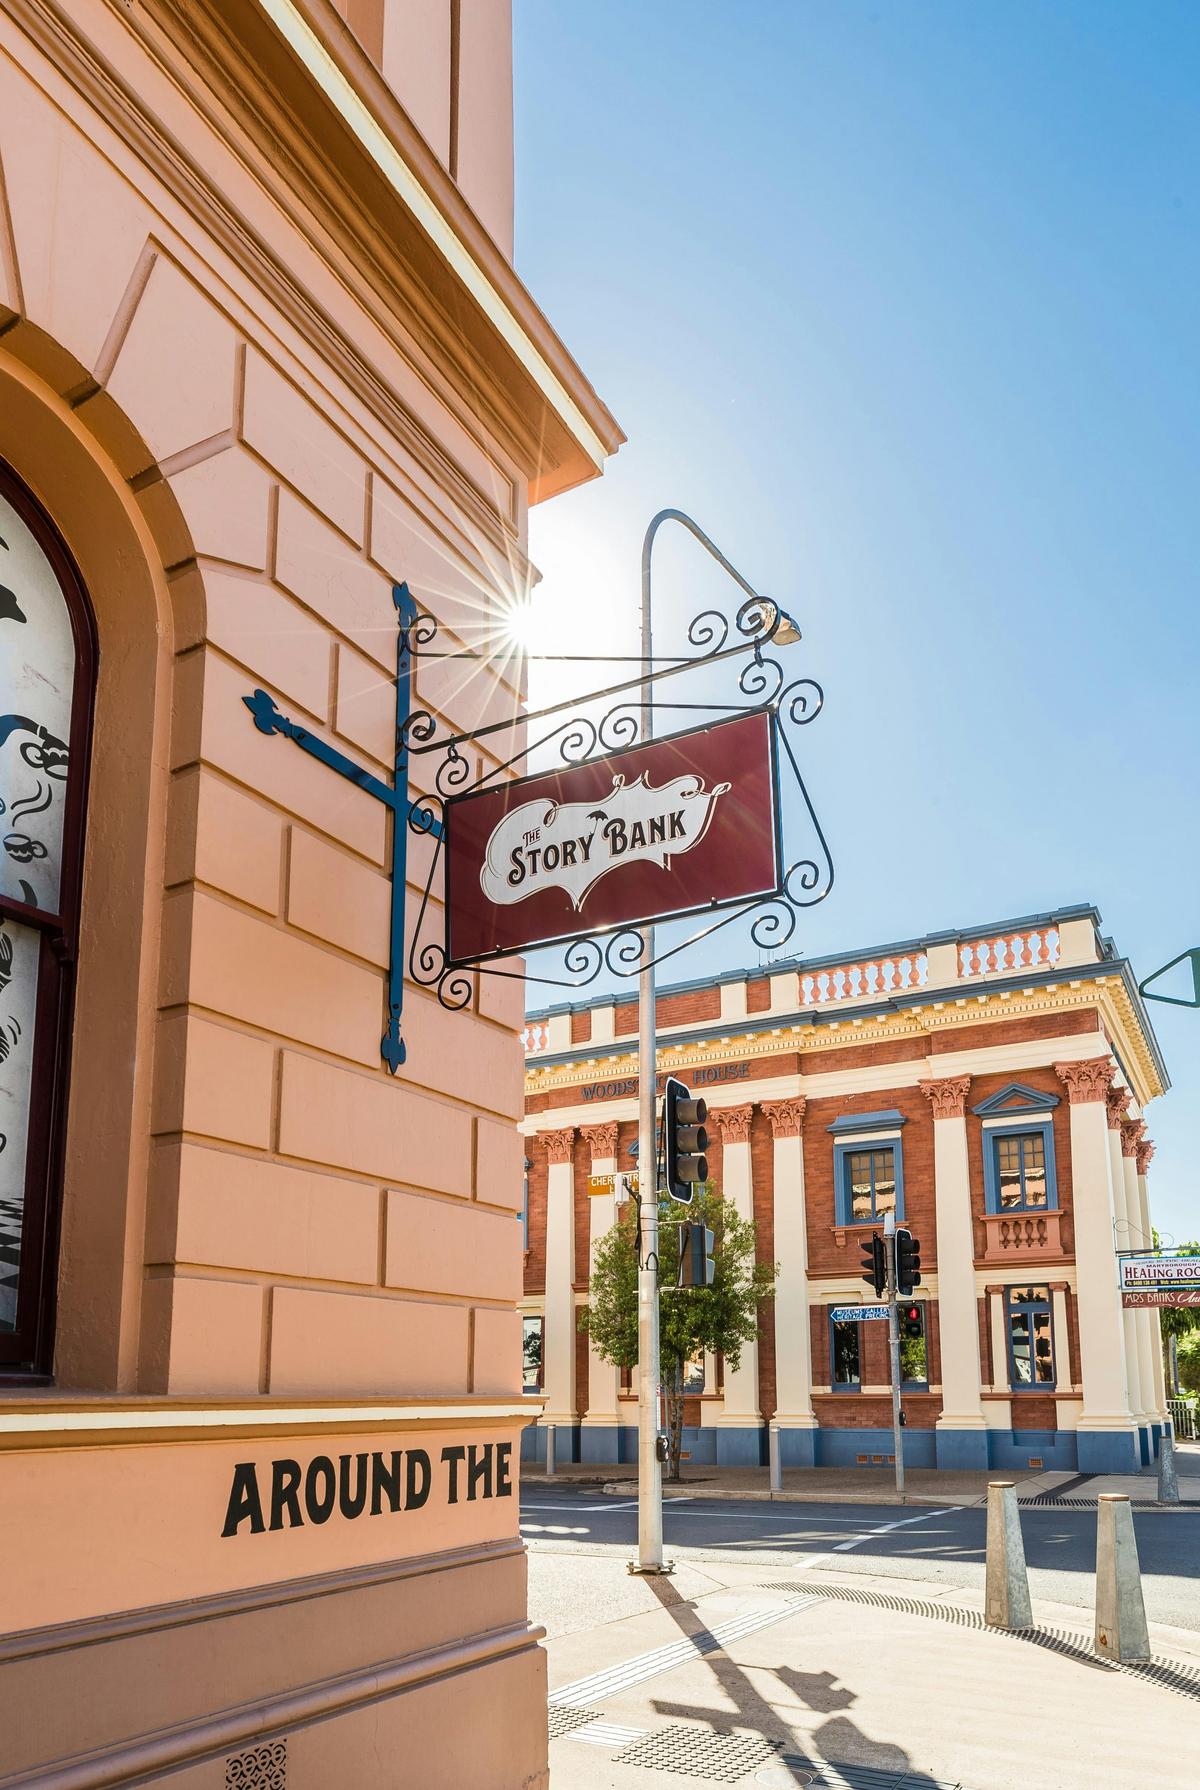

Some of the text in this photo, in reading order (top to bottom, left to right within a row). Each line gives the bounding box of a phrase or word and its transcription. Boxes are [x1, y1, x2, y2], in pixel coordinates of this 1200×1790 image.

[508, 809, 687, 885] STORY BANK
[522, 827, 541, 847] THE
[581, 1063, 750, 1100] WOODSC HOUSE
[1125, 1266, 1173, 1279] HEALING
[1126, 1293, 1144, 1304] MRS
[1147, 1292, 1175, 1303] BANKS
[221, 1442, 512, 1538] AROUND THE
